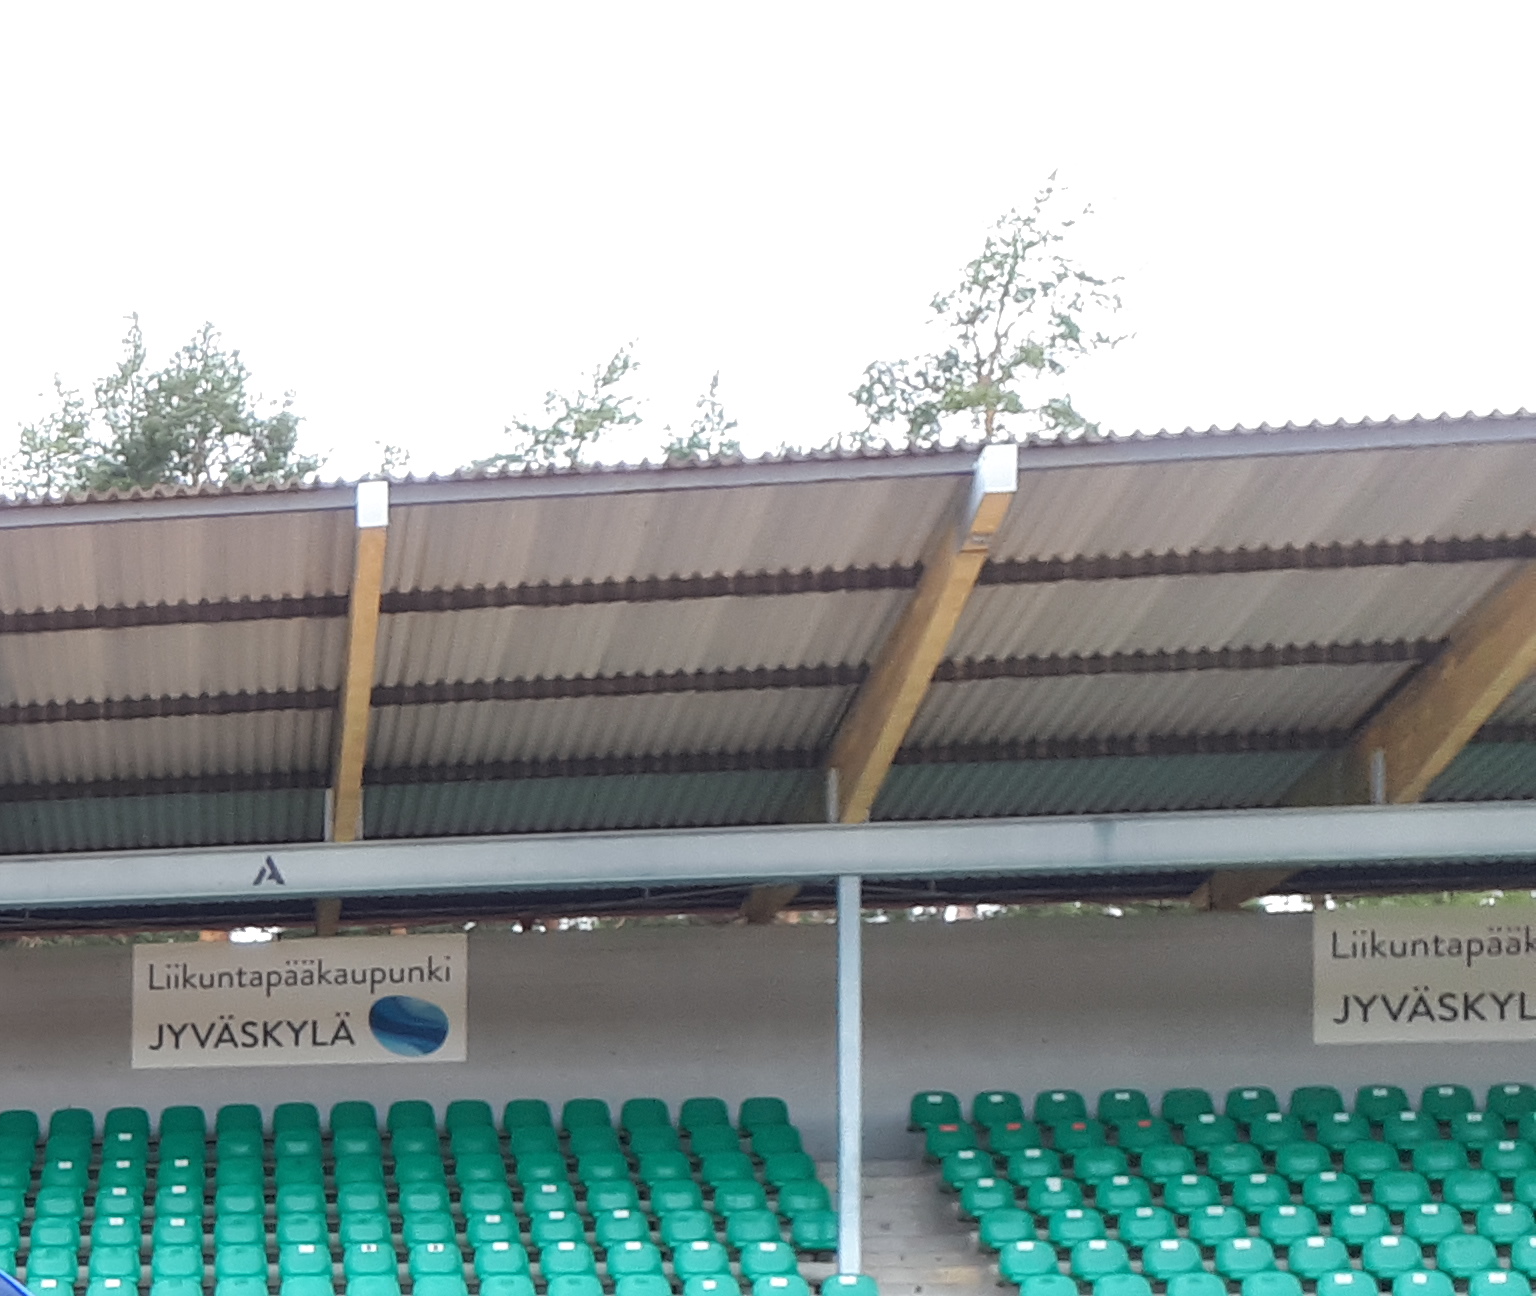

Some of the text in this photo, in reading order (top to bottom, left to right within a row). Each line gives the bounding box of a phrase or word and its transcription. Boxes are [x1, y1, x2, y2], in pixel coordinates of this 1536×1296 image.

[252, 855, 285, 886] A
[148, 956, 452, 998] Liikuntapääkaupunki
[148, 1011, 355, 1050] JYVÄSKYLÄ
